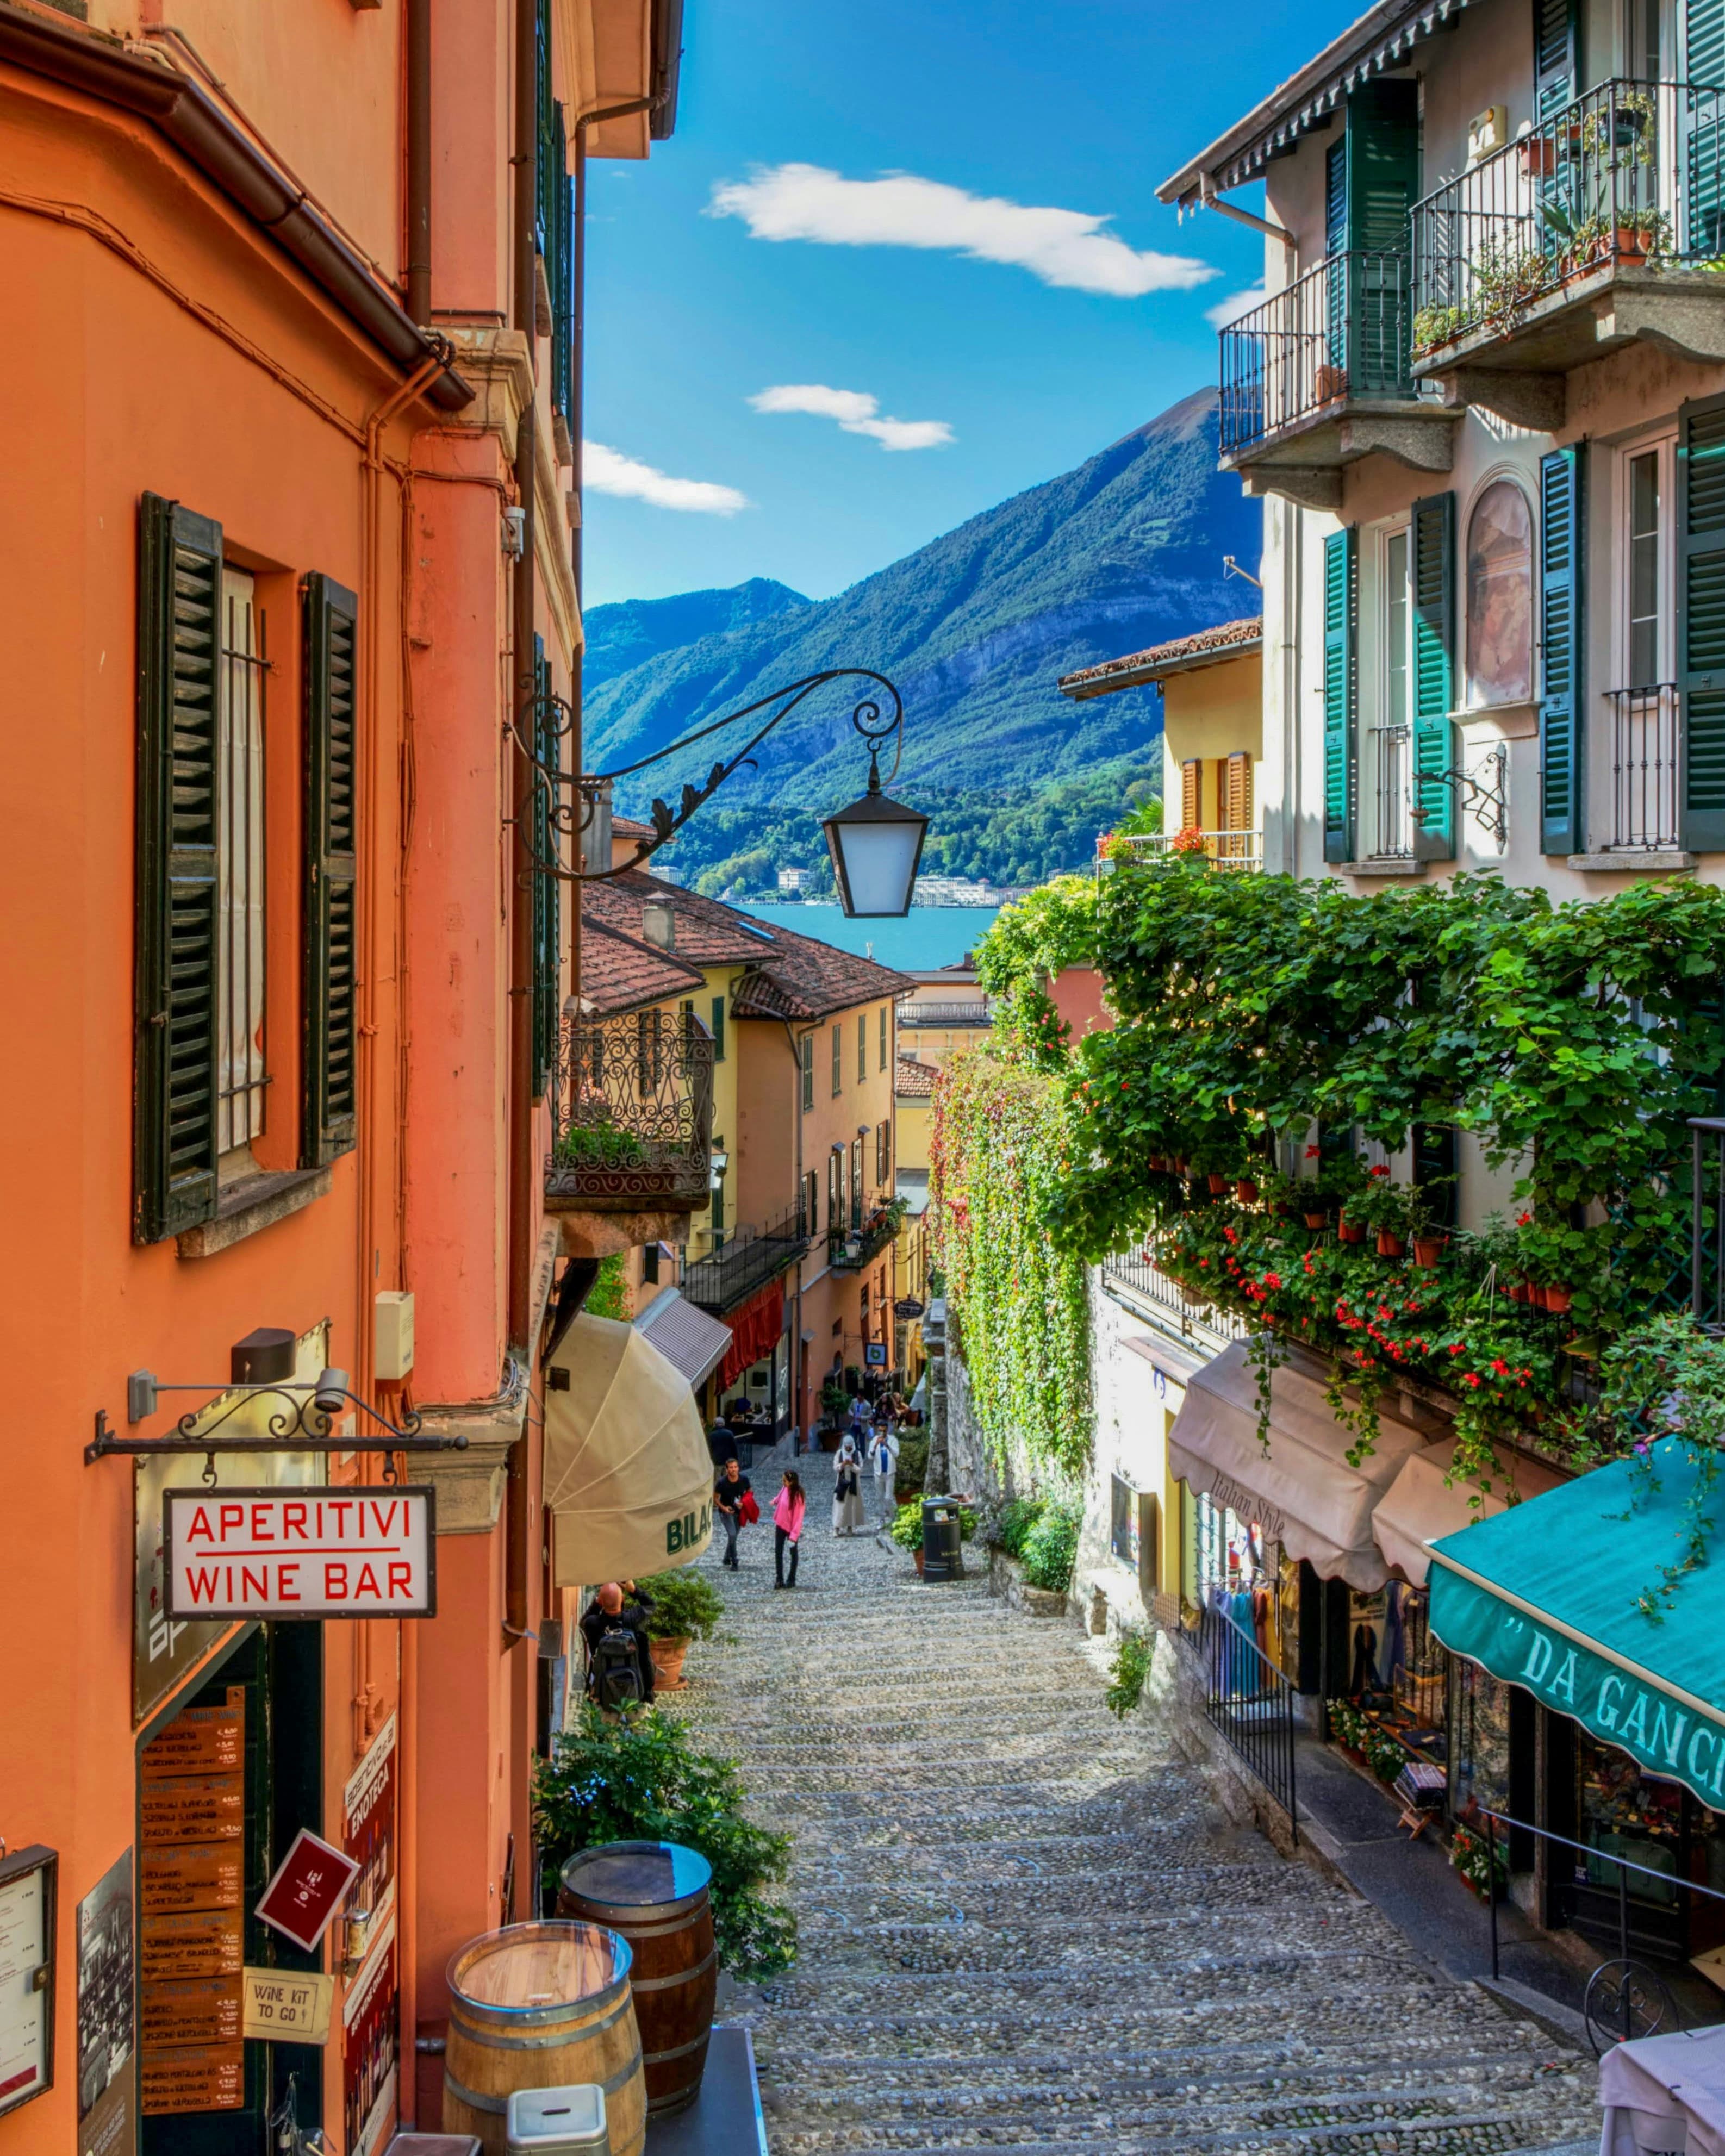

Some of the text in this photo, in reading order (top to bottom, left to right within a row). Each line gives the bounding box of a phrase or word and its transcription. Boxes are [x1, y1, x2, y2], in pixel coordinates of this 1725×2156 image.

[186, 1500, 409, 1542] APERITIVI
[1211, 1470, 1285, 1538] Italian Style
[185, 1562, 414, 1604] WINE BAR
[352, 1762, 389, 1840] ENOTECA
[258, 2003, 273, 2018] TO
[279, 2007, 296, 2022] GO
